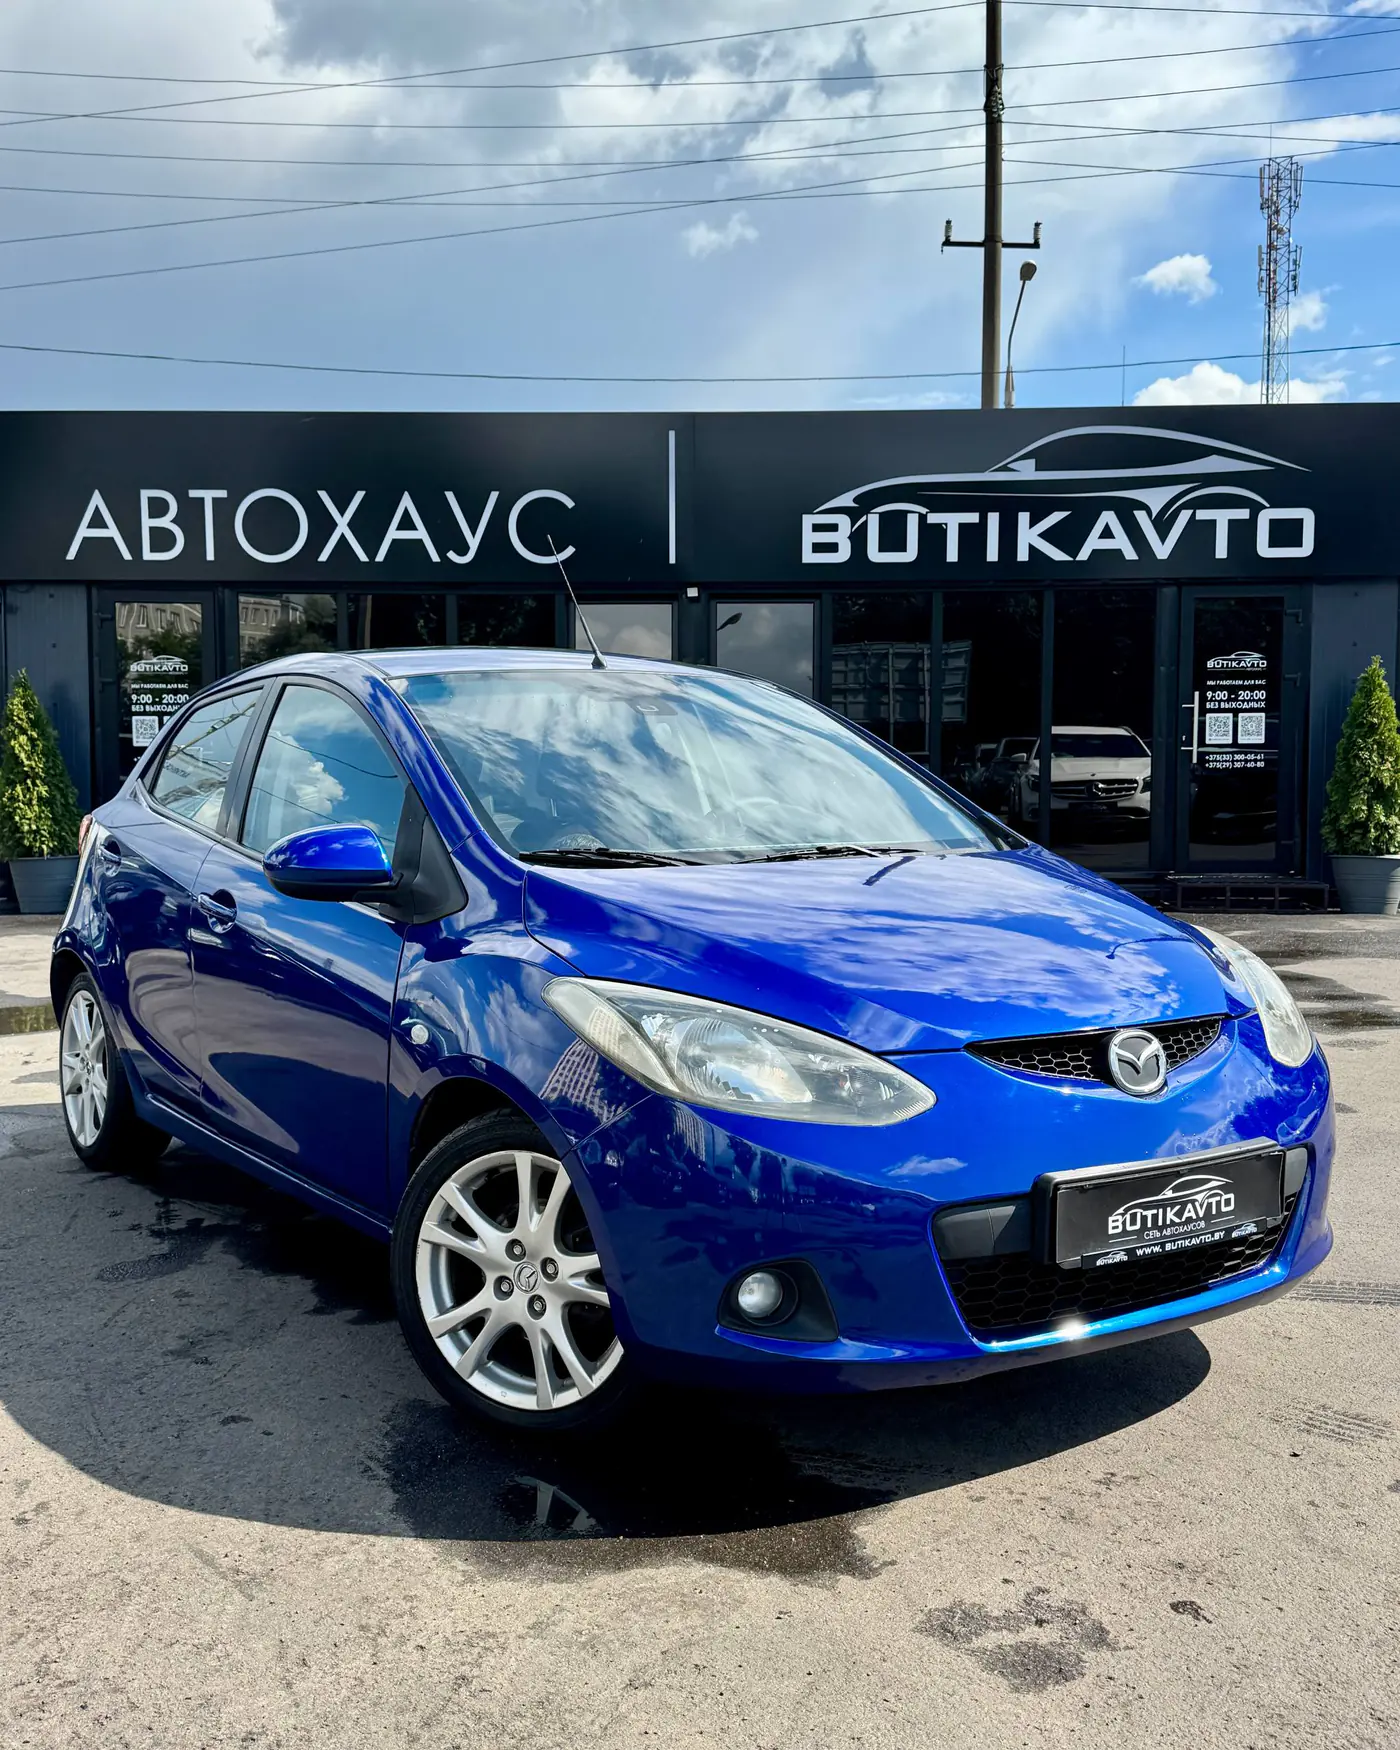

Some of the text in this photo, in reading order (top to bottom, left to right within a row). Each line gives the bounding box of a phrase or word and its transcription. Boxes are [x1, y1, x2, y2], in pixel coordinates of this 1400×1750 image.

[65, 487, 577, 565] АВТОХАУС
[801, 506, 1316, 565] BUTIKAVTO
[1206, 660, 1267, 668] BUTIKAVTO
[131, 694, 152, 704] 9:00
[161, 694, 189, 704] 20:00
[1206, 690, 1228, 701] 9:00
[1237, 690, 1266, 700] 20:00
[131, 704, 181, 712] БЕЗ ВЫХОДН
[1206, 701, 1266, 709] БЕЗ ВЫХОДНЫХ
[1107, 1193, 1236, 1235] BUTIKAVTO
[1143, 1220, 1206, 1240] СЕТЬ АВТОХАУСОВ
[1135, 1231, 1226, 1257] WWW. BUTIKAVTO.BY
